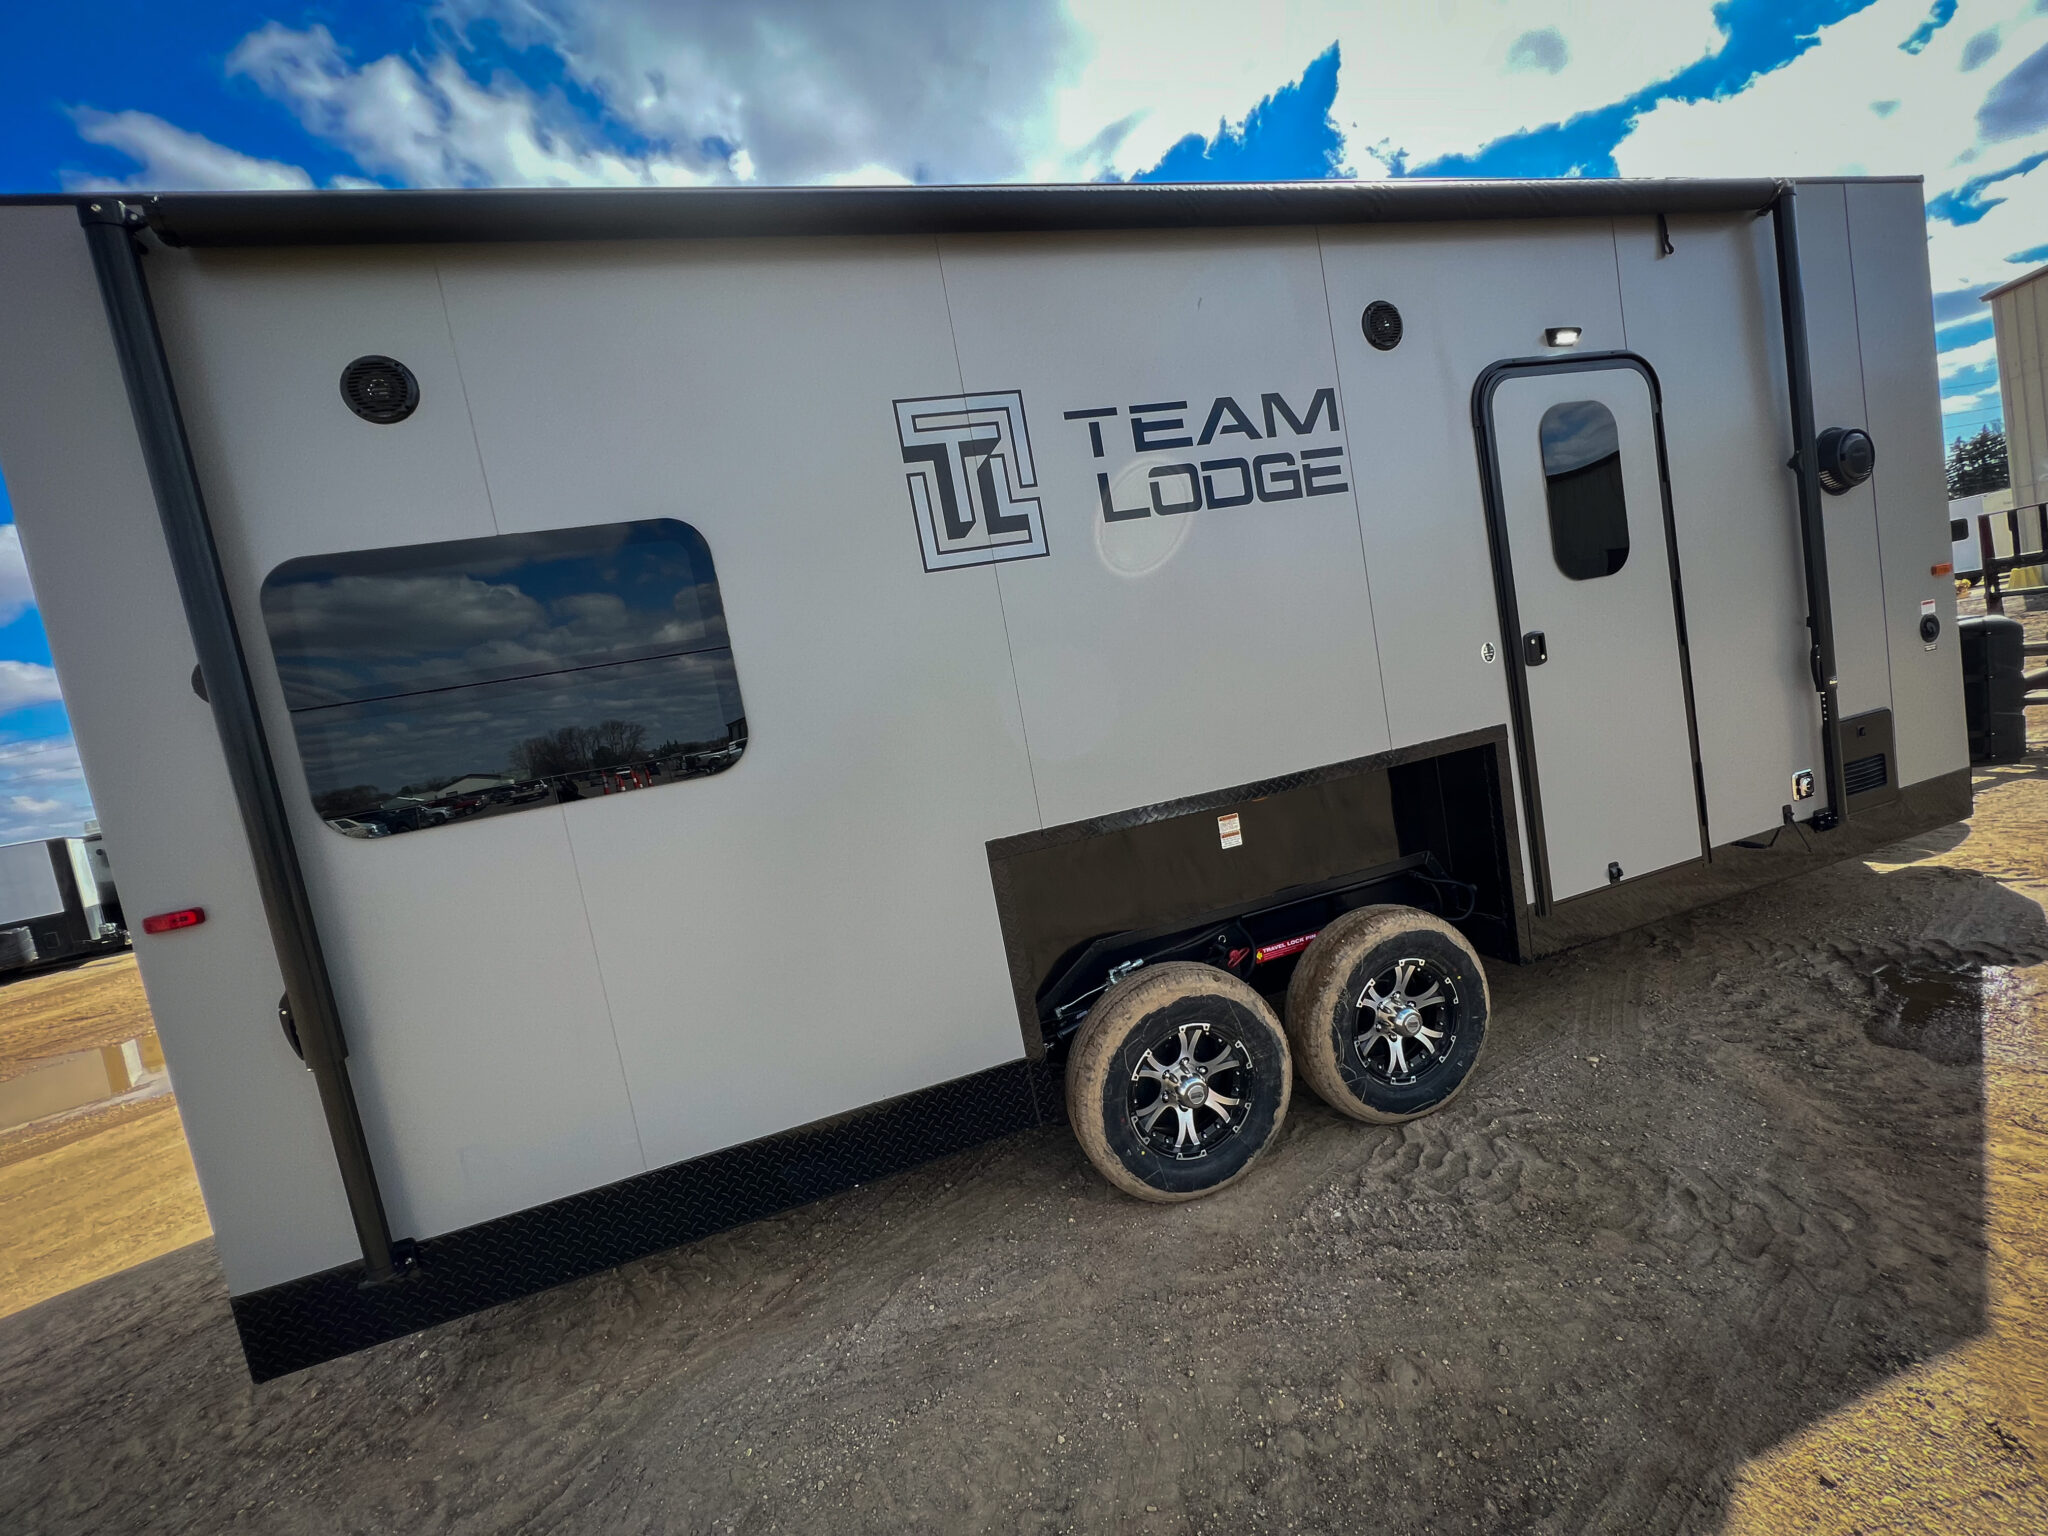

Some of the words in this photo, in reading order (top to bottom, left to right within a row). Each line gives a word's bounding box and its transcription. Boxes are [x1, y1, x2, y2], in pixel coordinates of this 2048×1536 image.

[1063, 388, 1340, 458] TEAM
[1097, 446, 1349, 523] LODGE
[1263, 943, 1286, 953] TRAVEL
[1287, 937, 1304, 946] LOCK
